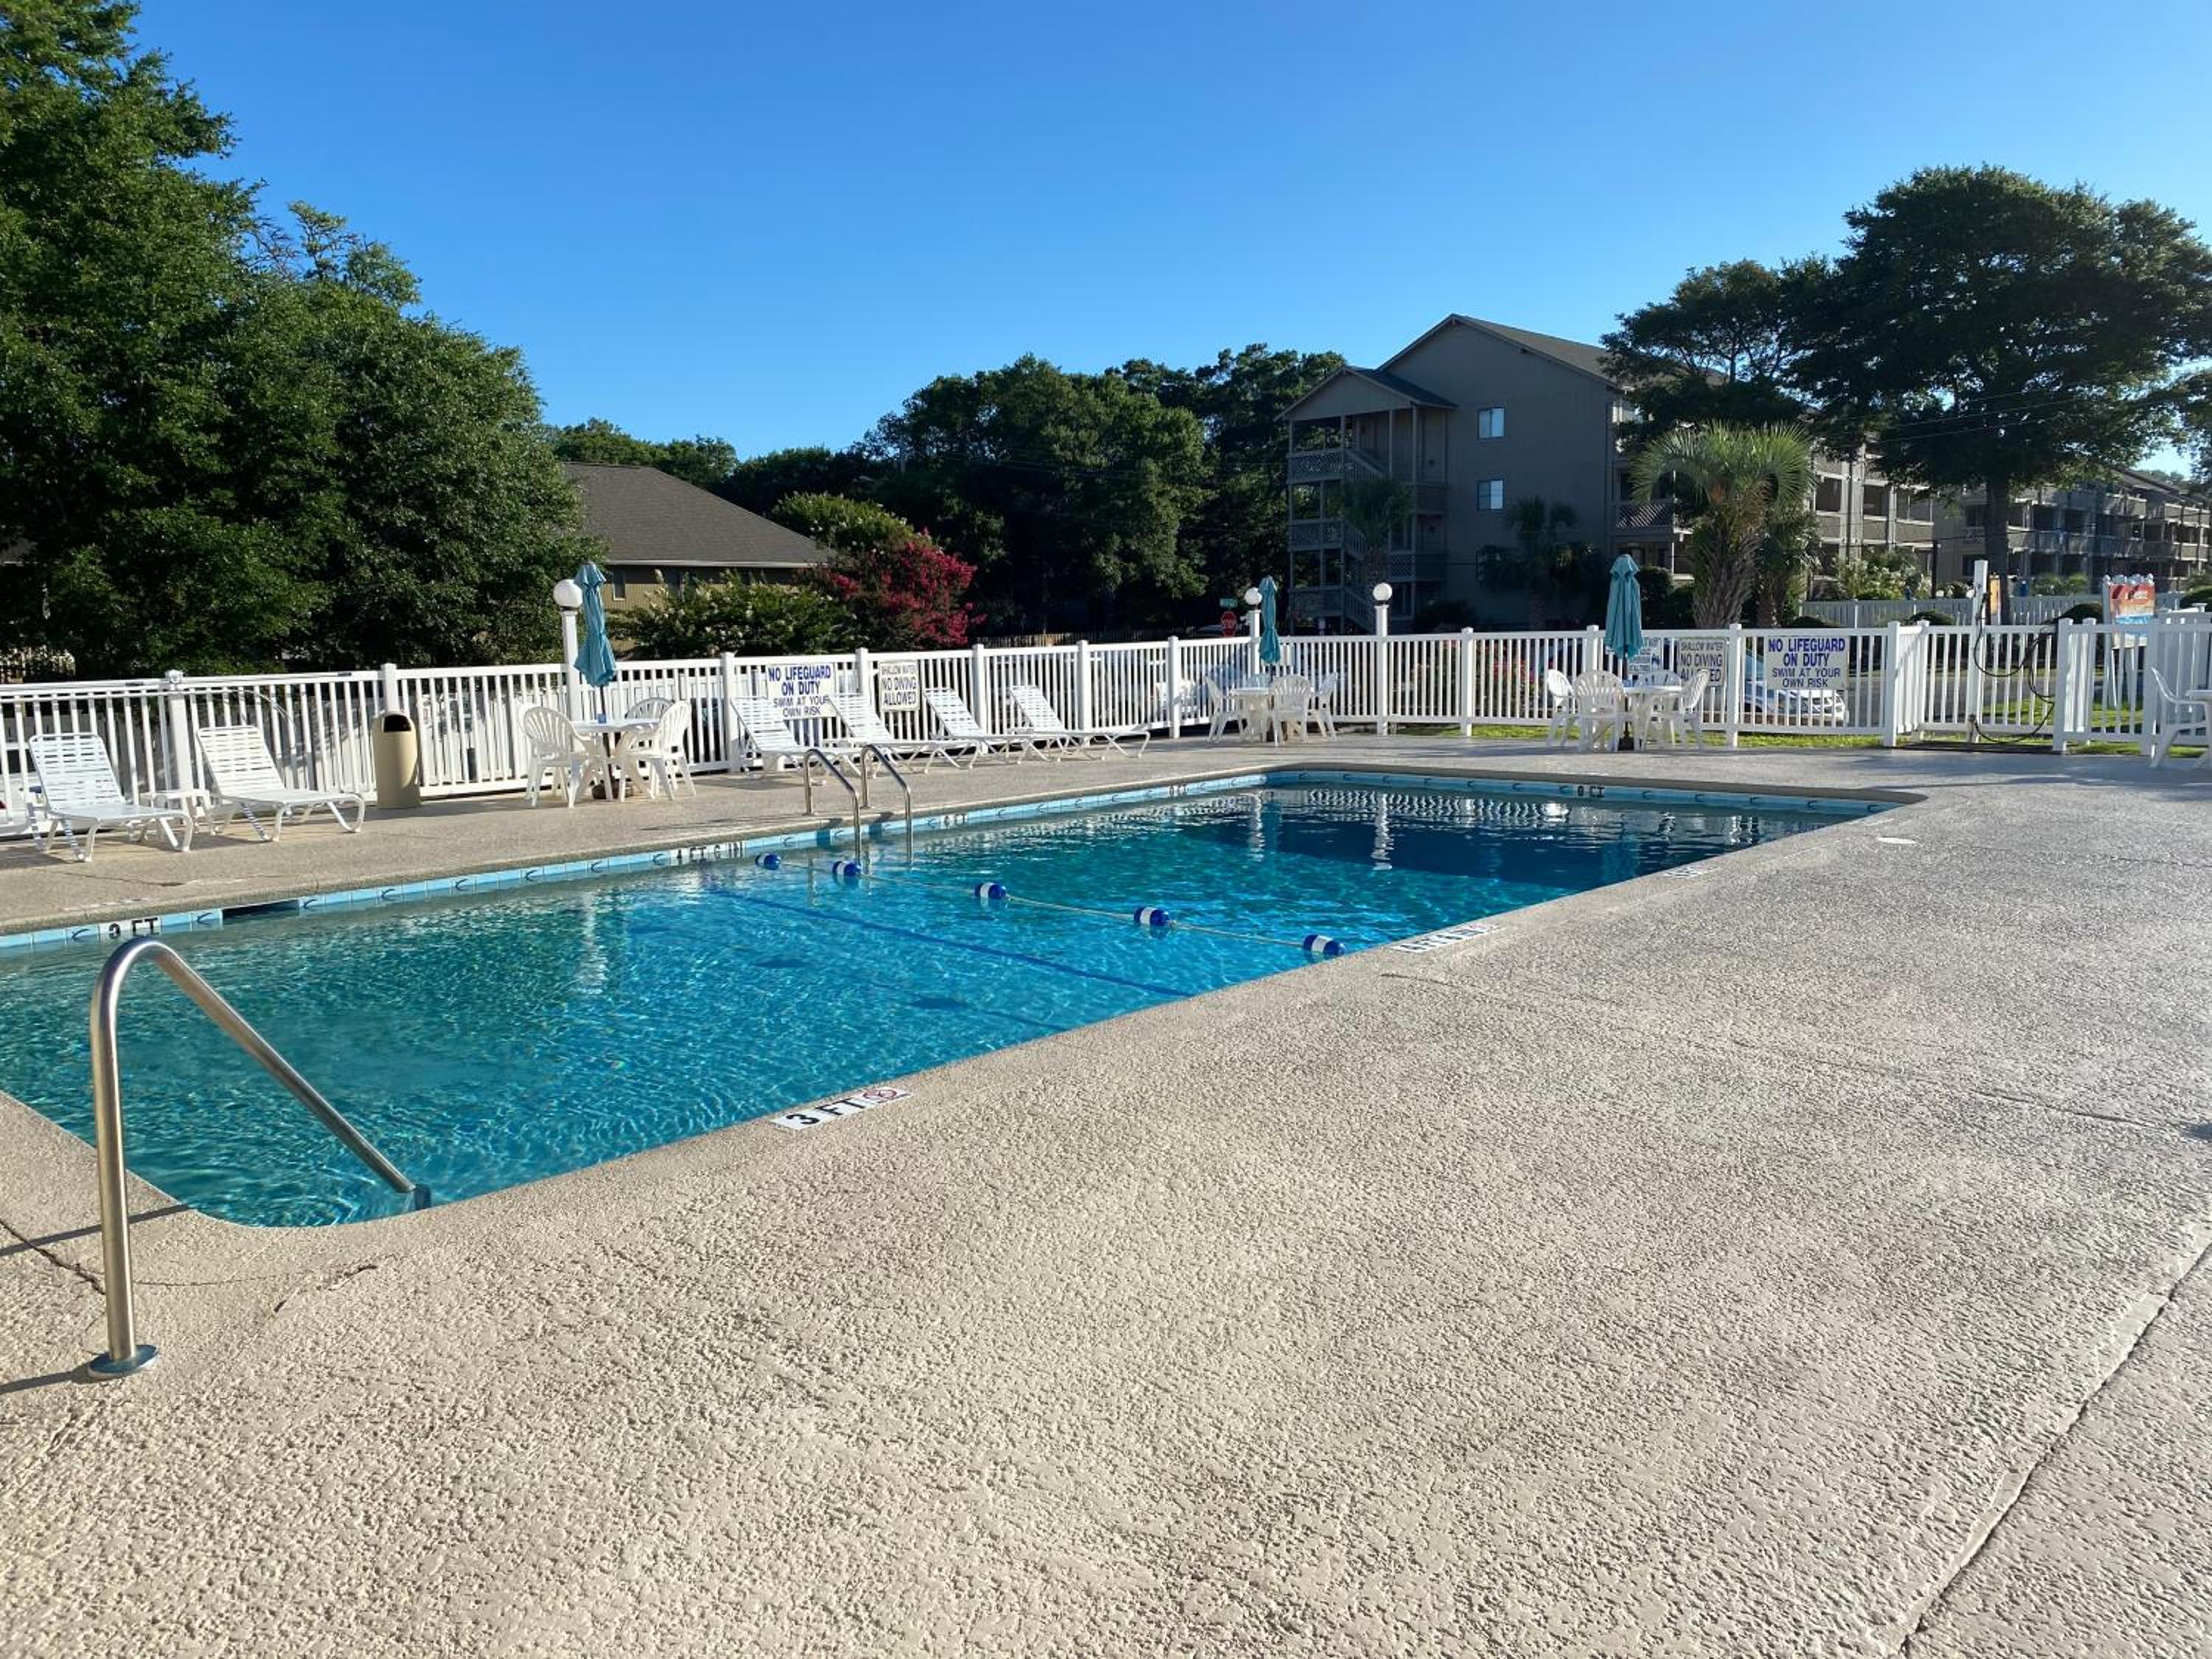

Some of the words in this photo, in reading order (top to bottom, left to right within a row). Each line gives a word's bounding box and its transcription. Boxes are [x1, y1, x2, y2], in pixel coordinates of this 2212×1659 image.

[1769, 639, 1783, 652] NO
[1788, 638, 1846, 652] LIFEGUARD
[1681, 654, 1692, 667] NO
[1694, 653, 1722, 667] DIVING
[1783, 653, 1798, 667] ON
[1804, 653, 1829, 667] DUTY
[768, 667, 781, 681] NO
[785, 665, 831, 680] LIFEGUARD
[1772, 668, 1795, 677] SWIM
[1799, 668, 1811, 677] AT
[1815, 668, 1840, 677] YOUR
[782, 682, 794, 695] ON
[798, 681, 820, 695] DUTY
[882, 678, 892, 690] NO
[894, 676, 917, 690] DIVING
[1782, 678, 1804, 687] OWN
[1807, 678, 1829, 687] RISK
[797, 696, 806, 706] AT
[810, 695, 831, 706] YOUR
[883, 692, 917, 706] ALLOWED
[782, 707, 801, 717] OWN
[804, 706, 821, 715] RISK
[786, 1113, 821, 1124] 3
[815, 1099, 866, 1116] FT
